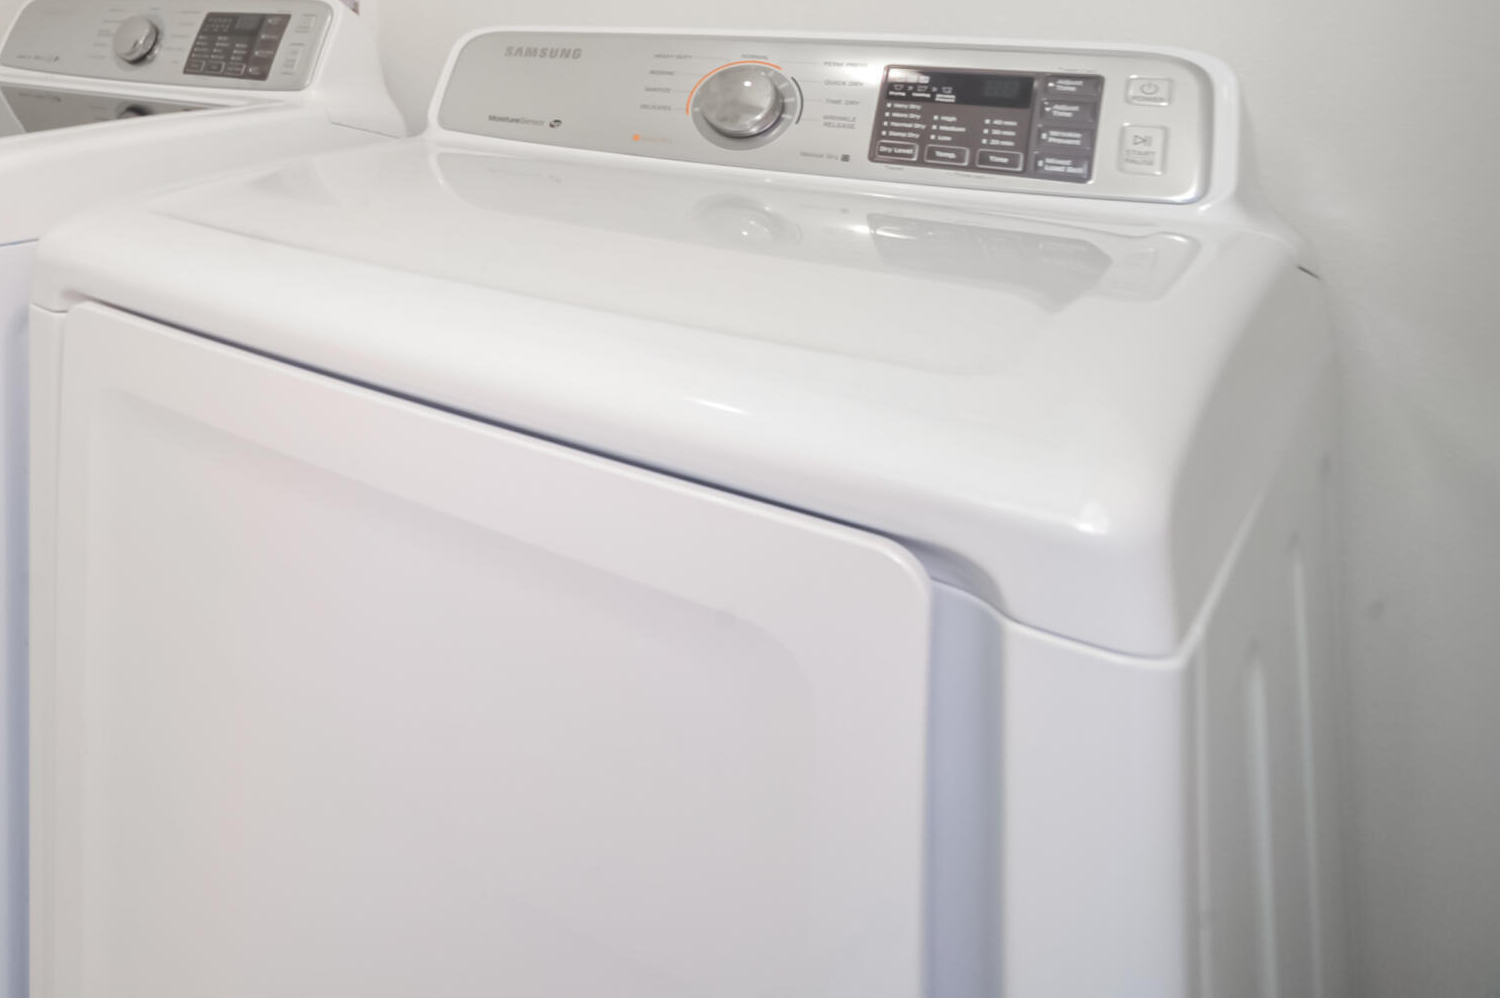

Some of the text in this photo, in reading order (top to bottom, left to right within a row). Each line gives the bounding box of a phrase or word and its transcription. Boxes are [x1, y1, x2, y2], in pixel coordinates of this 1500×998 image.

[504, 45, 583, 60] SAMSUNG
[879, 145, 914, 155] Dry Level
